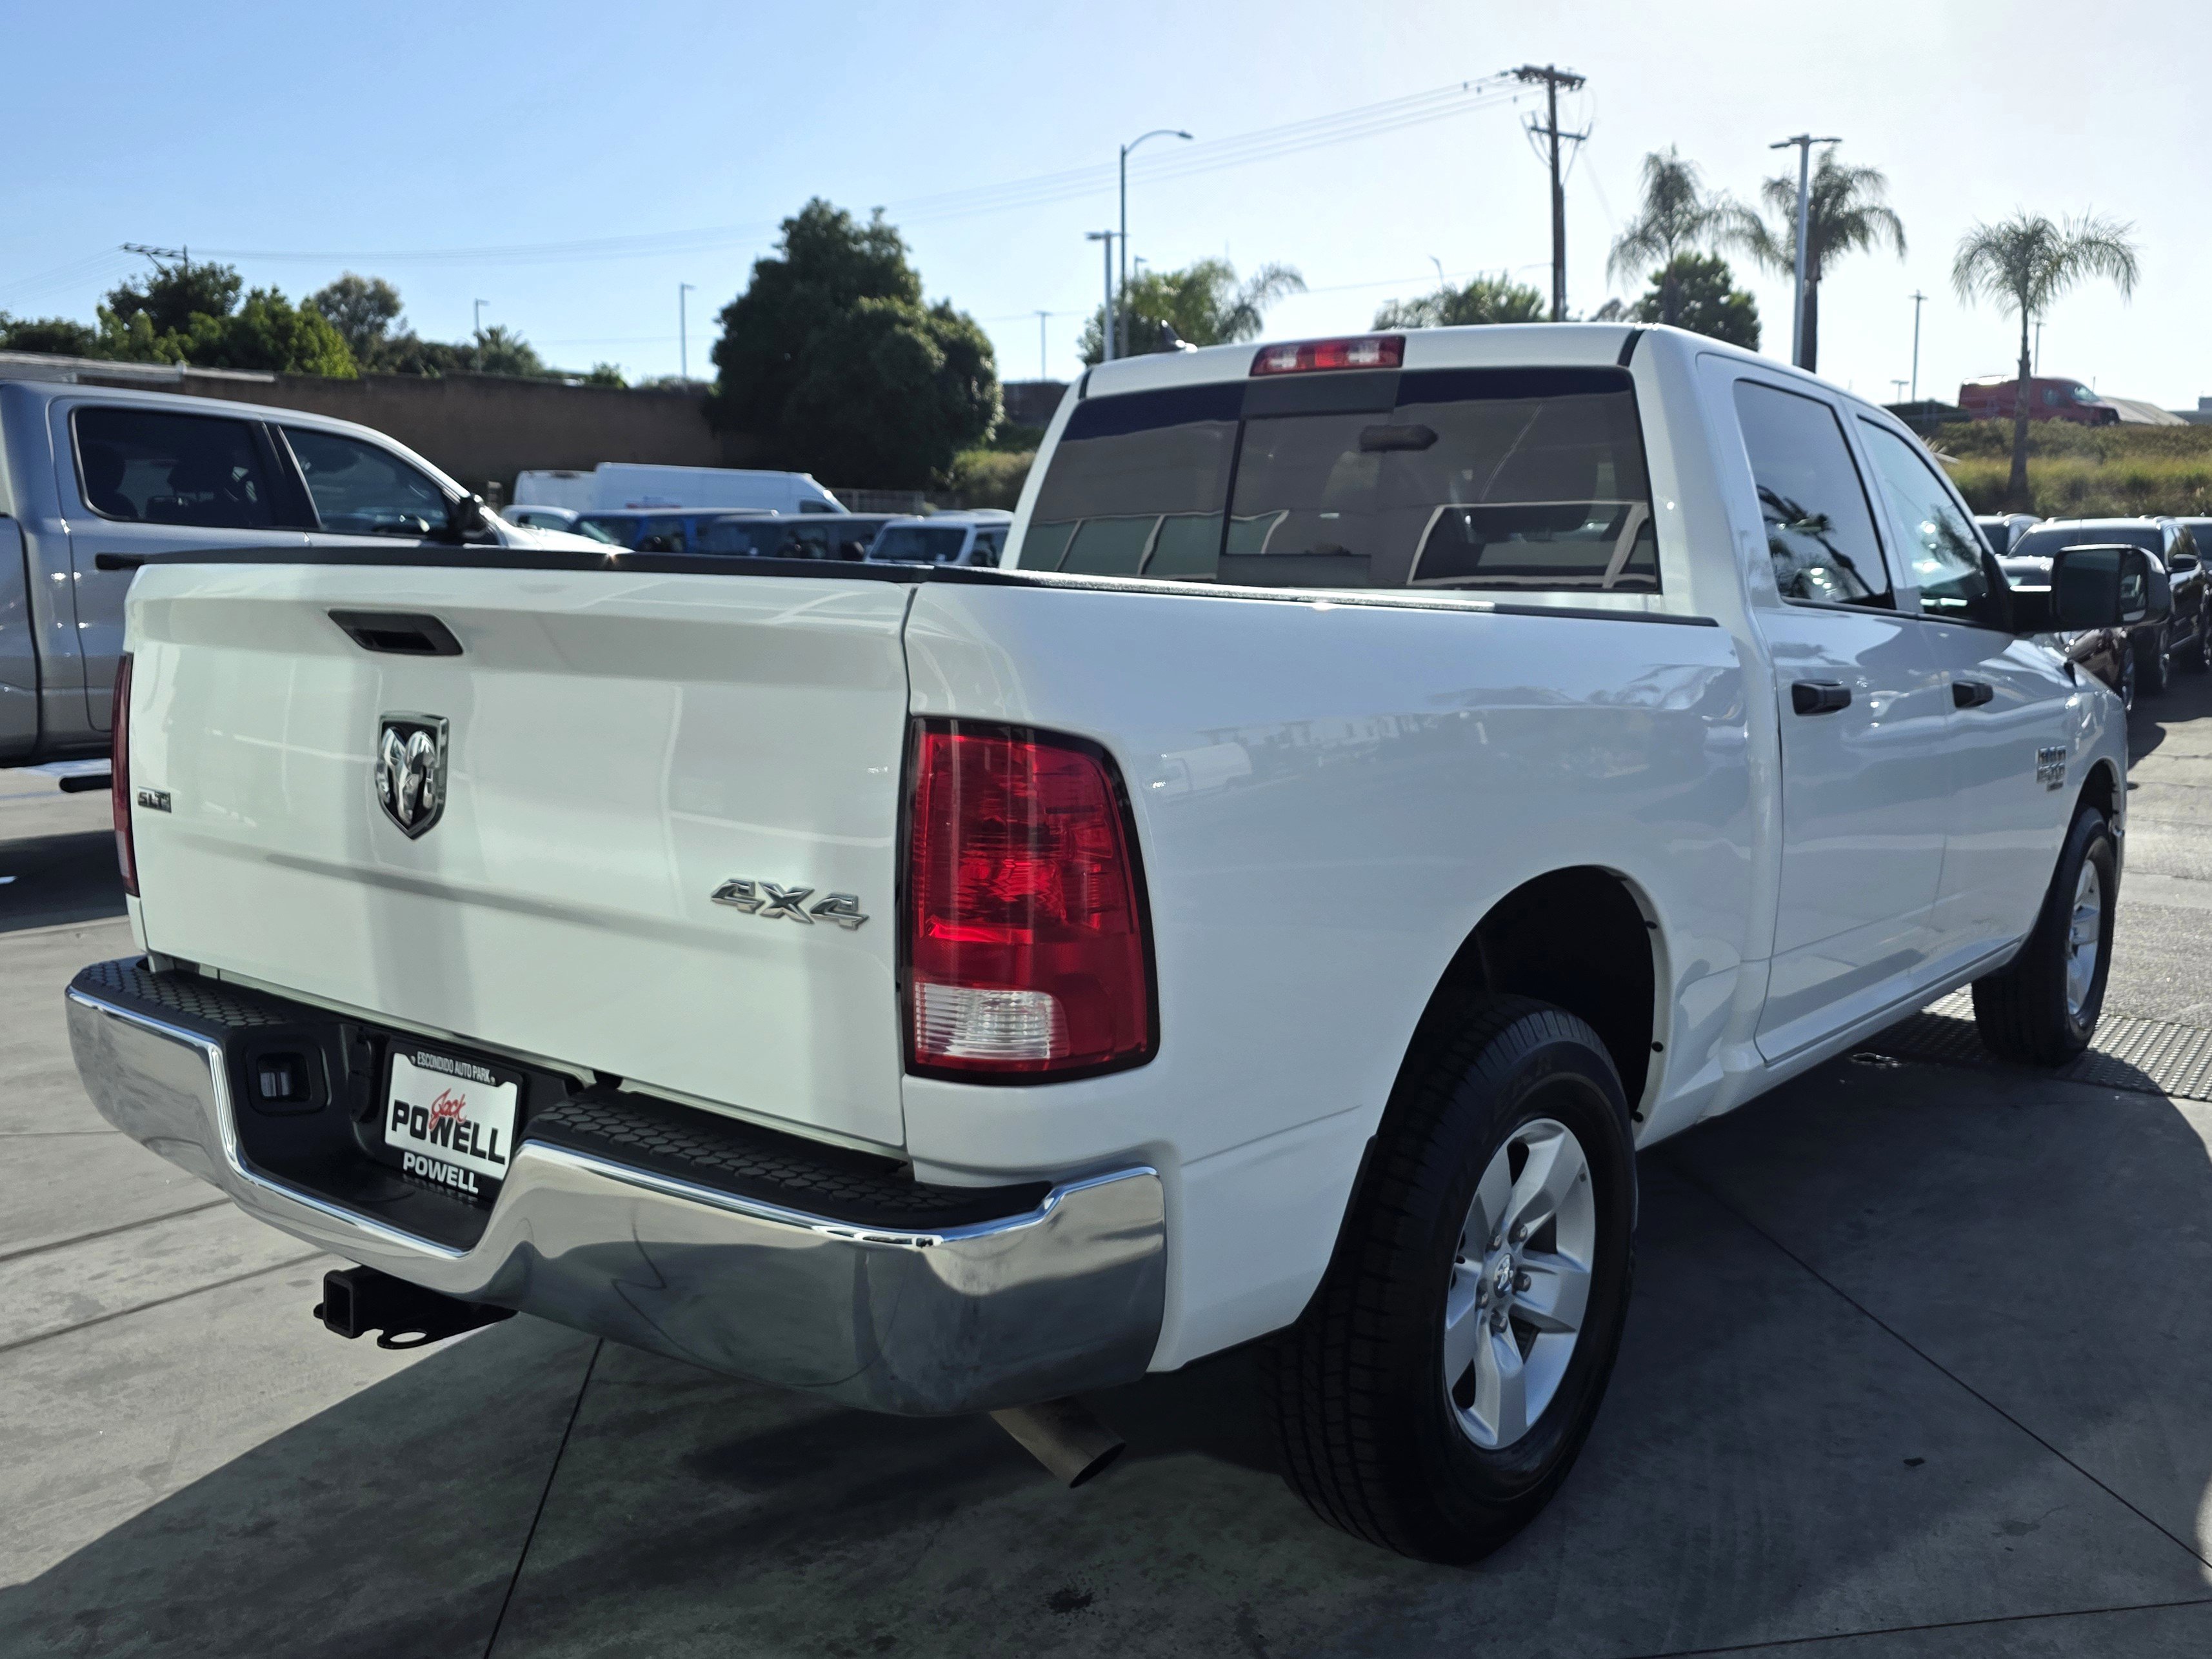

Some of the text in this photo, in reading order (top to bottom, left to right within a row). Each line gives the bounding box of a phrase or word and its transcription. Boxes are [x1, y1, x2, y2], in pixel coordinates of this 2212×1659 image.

[137, 789, 171, 812] SLT
[710, 878, 870, 931] 4X4
[417, 1051, 491, 1083] ESCONDIDO AUTO PARK
[429, 1088, 467, 1130] Jack
[392, 1100, 506, 1165] POWELL
[403, 1152, 479, 1194] POWELL
